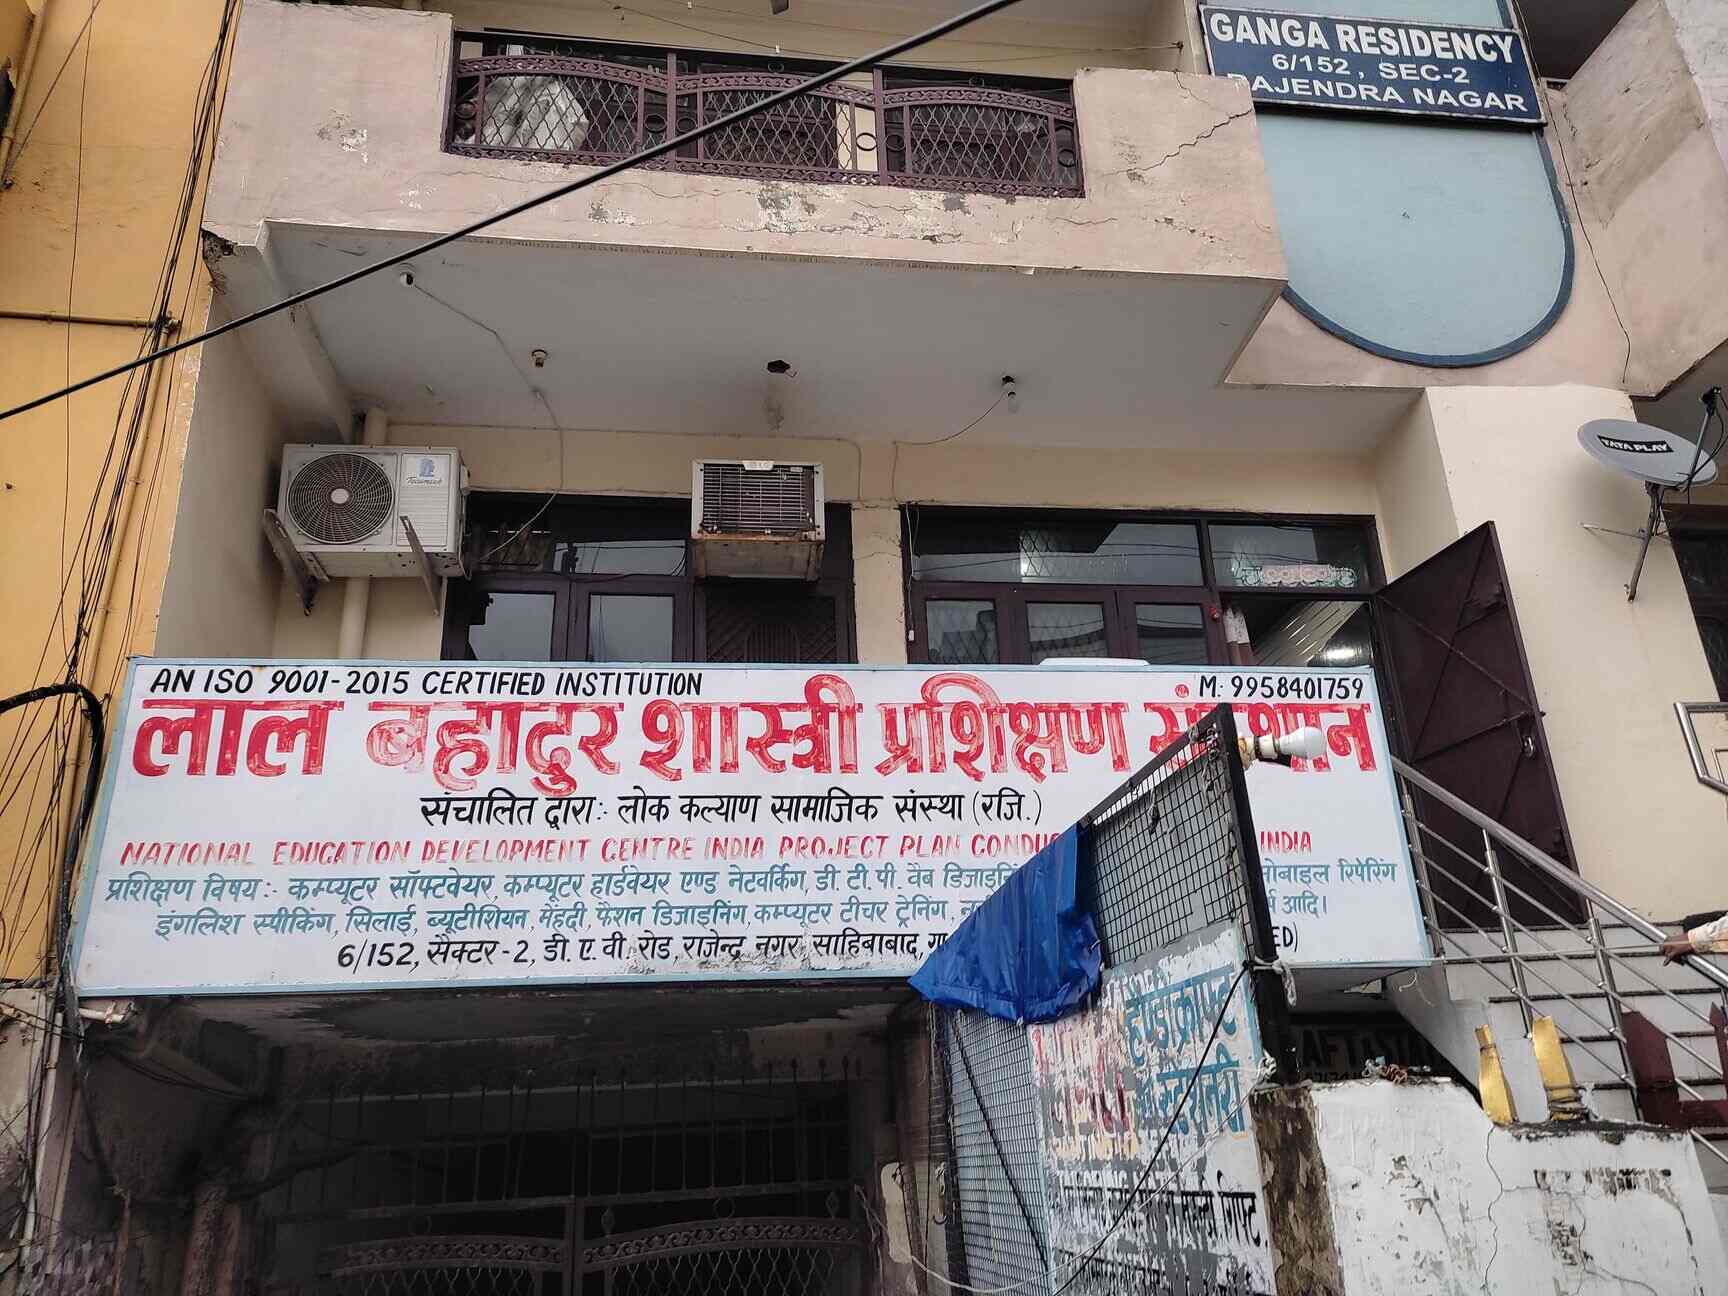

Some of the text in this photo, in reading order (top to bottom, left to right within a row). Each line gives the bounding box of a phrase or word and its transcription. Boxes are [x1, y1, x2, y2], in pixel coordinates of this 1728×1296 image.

[1210, 13, 1513, 64] GANGA RESIDENCY
[1379, 61, 1470, 84] SEC-2
[1413, 88, 1528, 112] NAGAR
[1633, 443, 1668, 452] PLAY
[150, 669, 703, 696] AN ISO 9001-2015 CERTIFIED INSTITUTION
[1230, 675, 1364, 700] 9958401759
[132, 699, 344, 777] लाल
[366, 700, 625, 797] बहादुर
[639, 673, 864, 782] शास्त्री
[875, 673, 1129, 784] प्रशिक्षण
[420, 787, 538, 827] संचालित
[617, 786, 671, 824] लोक
[679, 795, 762, 825] कल्याण
[770, 786, 884, 824] सामाजिक
[893, 788, 966, 824] संस्था
[973, 787, 1042, 826] (रजि.)
[120, 841, 253, 865] NATIONAL
[272, 841, 411, 865] EDUCATION
[421, 839, 592, 864] DEVELOPMENT
[600, 837, 694, 863] CENTRE
[705, 837, 765, 862] INDIA
[779, 835, 889, 859] PROJECT
[899, 834, 960, 858] PLAN
[1260, 831, 1311, 854] INDIA
[1337, 857, 1397, 884] रिपेरिंग
[104, 871, 197, 907] प्रशिक्षण
[288, 876, 380, 905] कम्प्यूटर
[504, 873, 585, 902] कम्प्यूटर
[590, 865, 672, 898] हार्डवेयर
[681, 872, 719, 894] एण्ड
[155, 906, 245, 941] इंगलिश
[754, 903, 834, 928] कम्प्यूटर
[840, 895, 889, 923] टीचर
